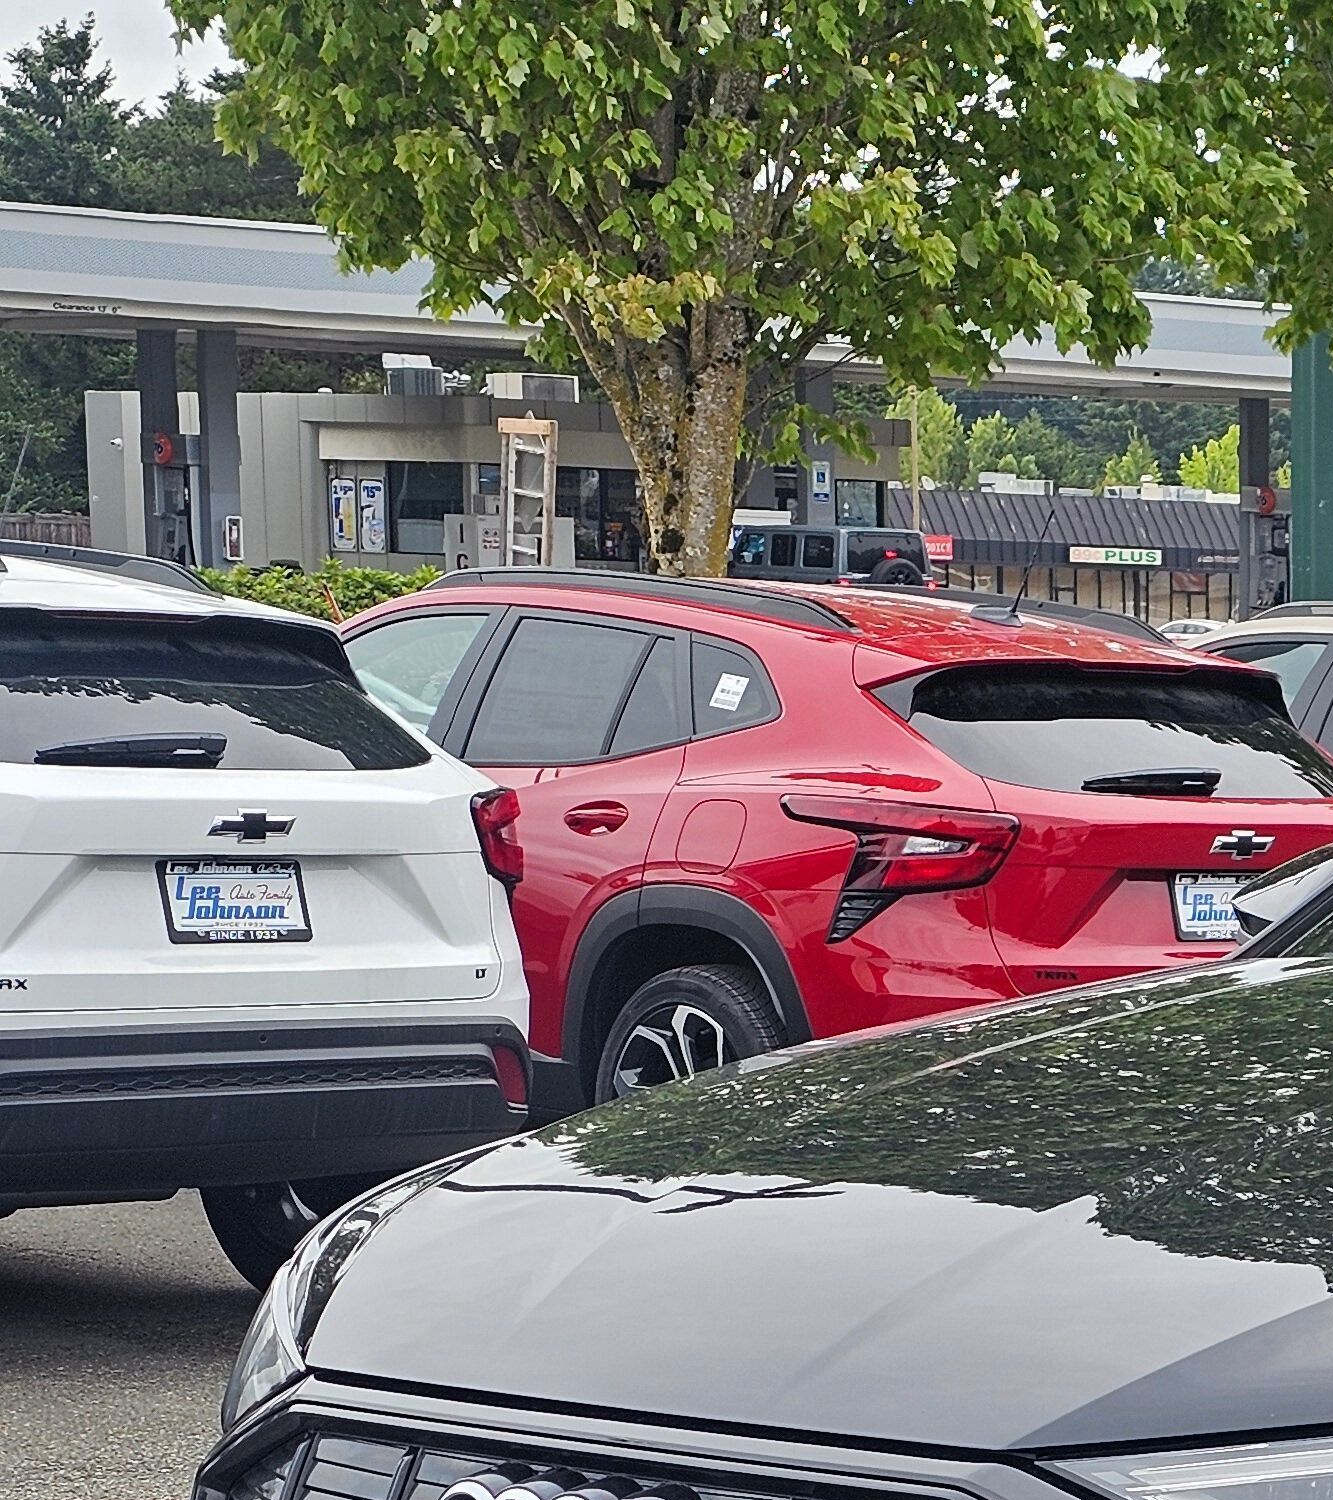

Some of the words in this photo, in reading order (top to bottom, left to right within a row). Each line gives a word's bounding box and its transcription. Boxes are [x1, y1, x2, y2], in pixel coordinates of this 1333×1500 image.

[1104, 550, 1157, 563] PLUS
[195, 861, 253, 873] Johnson
[176, 876, 225, 900] Lee
[230, 884, 256, 900] Auto
[257, 884, 294, 905] Family
[1183, 886, 1217, 905] Lee
[182, 890, 289, 919] Johnson
[1187, 897, 1239, 921] Johns
[209, 931, 246, 940] SINCE
[250, 930, 278, 940] 1933
[0, 979, 28, 990] AX
